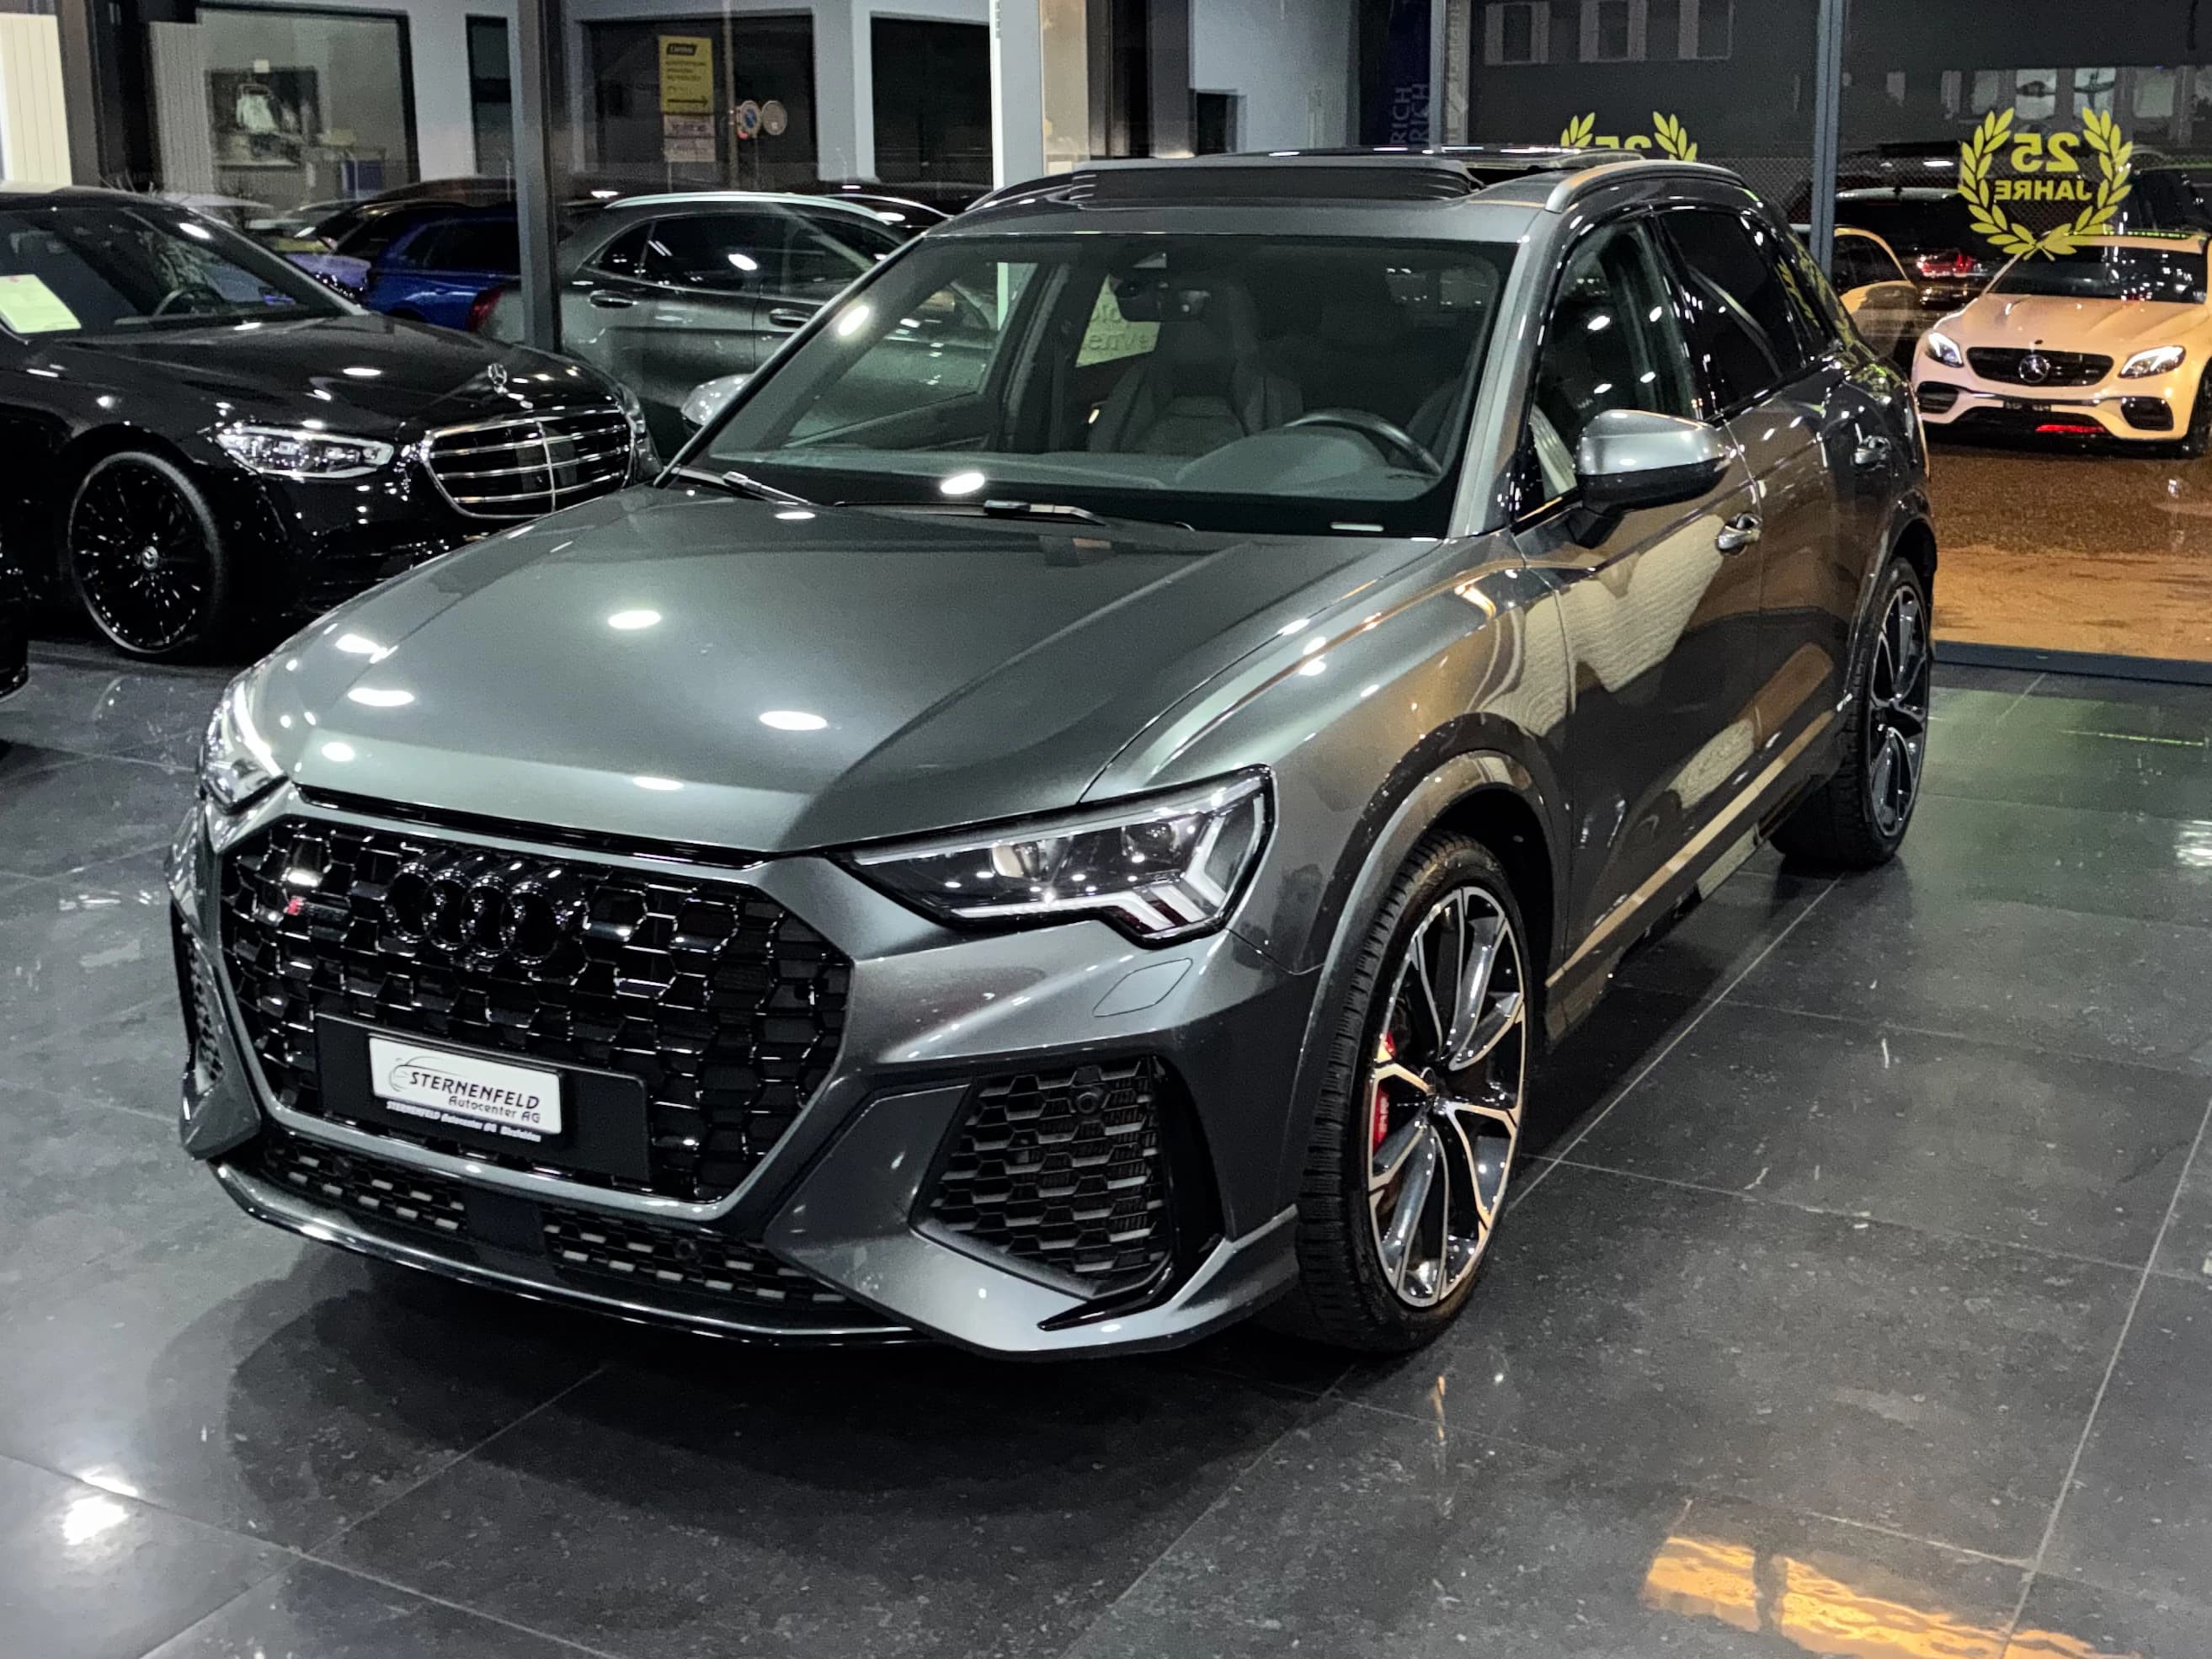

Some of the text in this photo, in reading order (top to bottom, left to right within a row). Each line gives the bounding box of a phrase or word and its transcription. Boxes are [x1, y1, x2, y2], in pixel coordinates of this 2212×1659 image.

[409, 1071, 541, 1110] STERNENFELD
[448, 1096, 541, 1123] Autocenter AG
